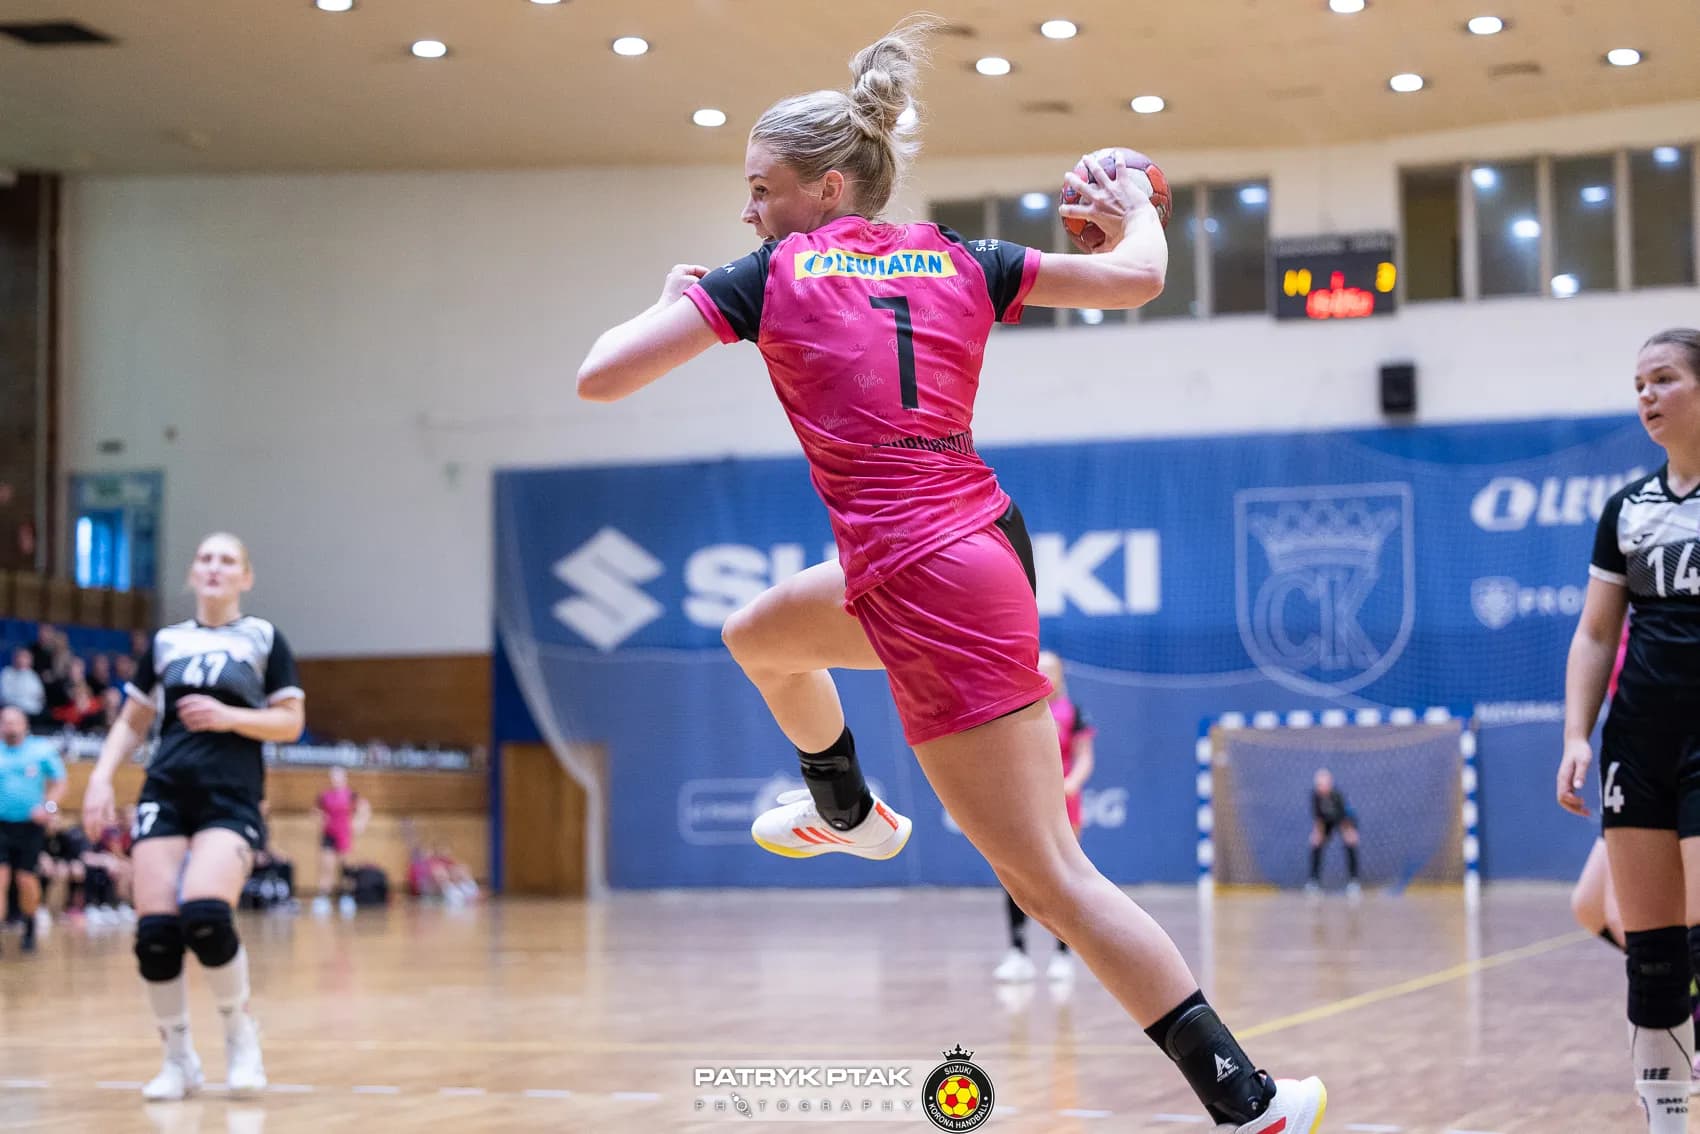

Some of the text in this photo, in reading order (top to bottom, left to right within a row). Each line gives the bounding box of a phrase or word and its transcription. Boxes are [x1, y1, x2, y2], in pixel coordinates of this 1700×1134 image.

[836, 253, 943, 276] LEWIATAN
[684, 529, 1161, 628] SKI
[1647, 541, 1700, 598] 14
[1517, 585, 1588, 617] PRO
